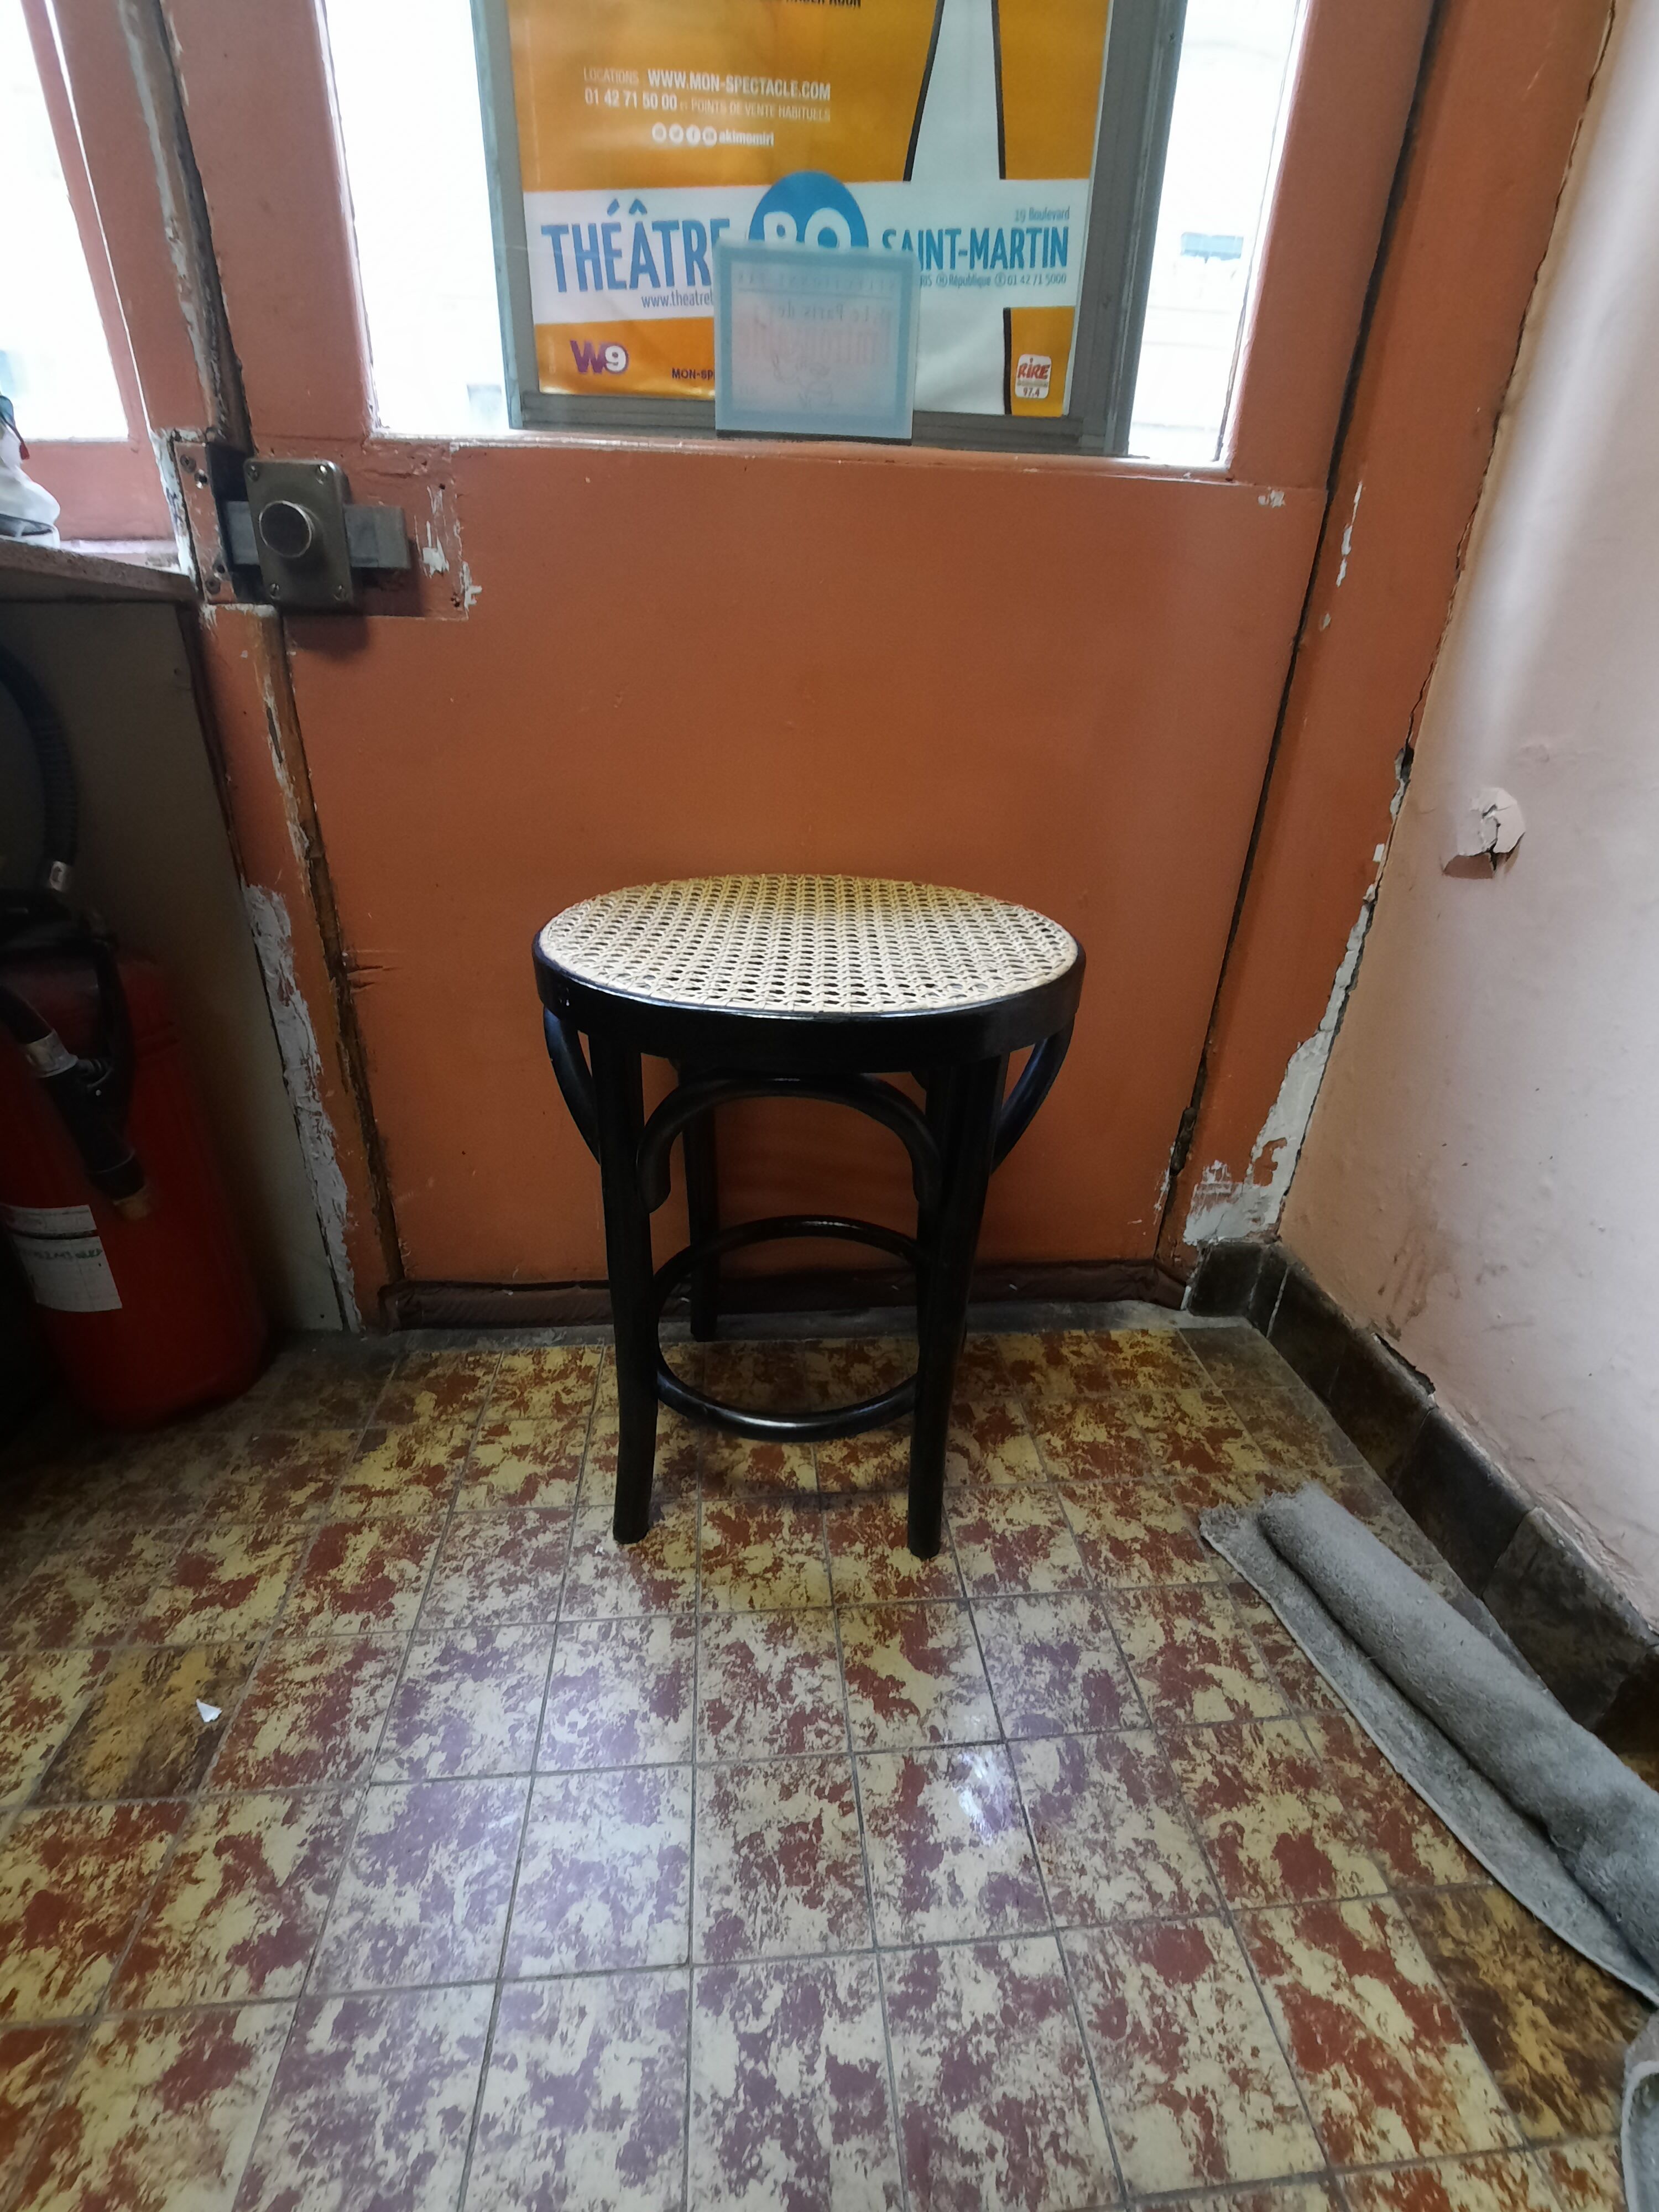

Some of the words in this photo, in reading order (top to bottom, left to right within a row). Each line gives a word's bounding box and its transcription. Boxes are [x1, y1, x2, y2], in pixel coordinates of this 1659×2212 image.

[584, 67, 639, 84] LOCATIONS
[648, 69, 830, 101] WWW.MON-SPECTACLE.COM
[585, 88, 599, 105] 01
[604, 88, 620, 107] 42
[623, 90, 638, 108] 71
[661, 93, 677, 111] 00
[1029, 206, 1070, 220] Boulevard
[949, 273, 992, 289] République
[570, 340, 628, 374] W9
[672, 368, 715, 380] MON-SP
